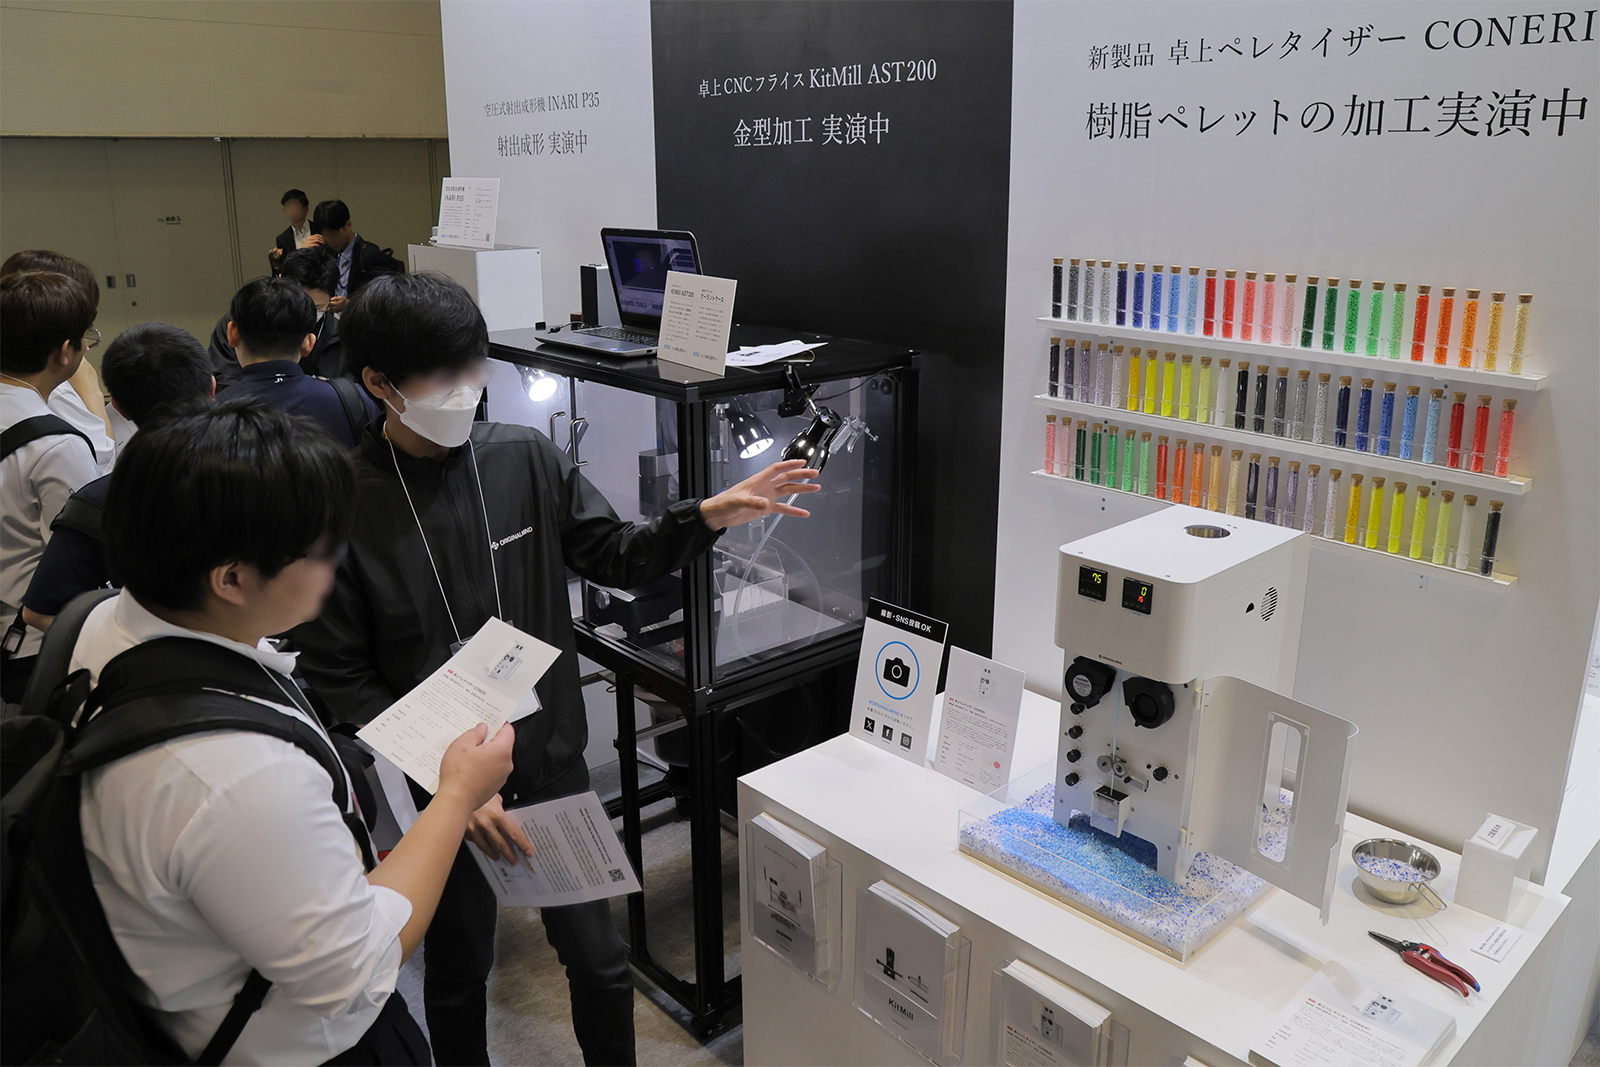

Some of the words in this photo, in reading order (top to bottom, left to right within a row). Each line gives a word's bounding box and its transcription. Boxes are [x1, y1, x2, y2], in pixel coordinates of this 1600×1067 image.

[1088, 41, 1154, 70] 新製品
[1168, 23, 1407, 65] 卓上ペレタイザー
[1424, 9, 1599, 51] CONERI
[808, 63, 863, 89] KitMill
[548, 94, 579, 111] INARI
[581, 91, 600, 109] P35
[1084, 87, 1588, 141] 樹脂ペレットの加工実演中
[732, 116, 814, 148] 金型加工
[821, 111, 890, 146] 実演中
[497, 132, 546, 157] 射出成形
[548, 129, 588, 155] 実演中
[1092, 572, 1102, 584] 75
[1140, 586, 1148, 597] 0
[888, 998, 914, 1021] KitMill
